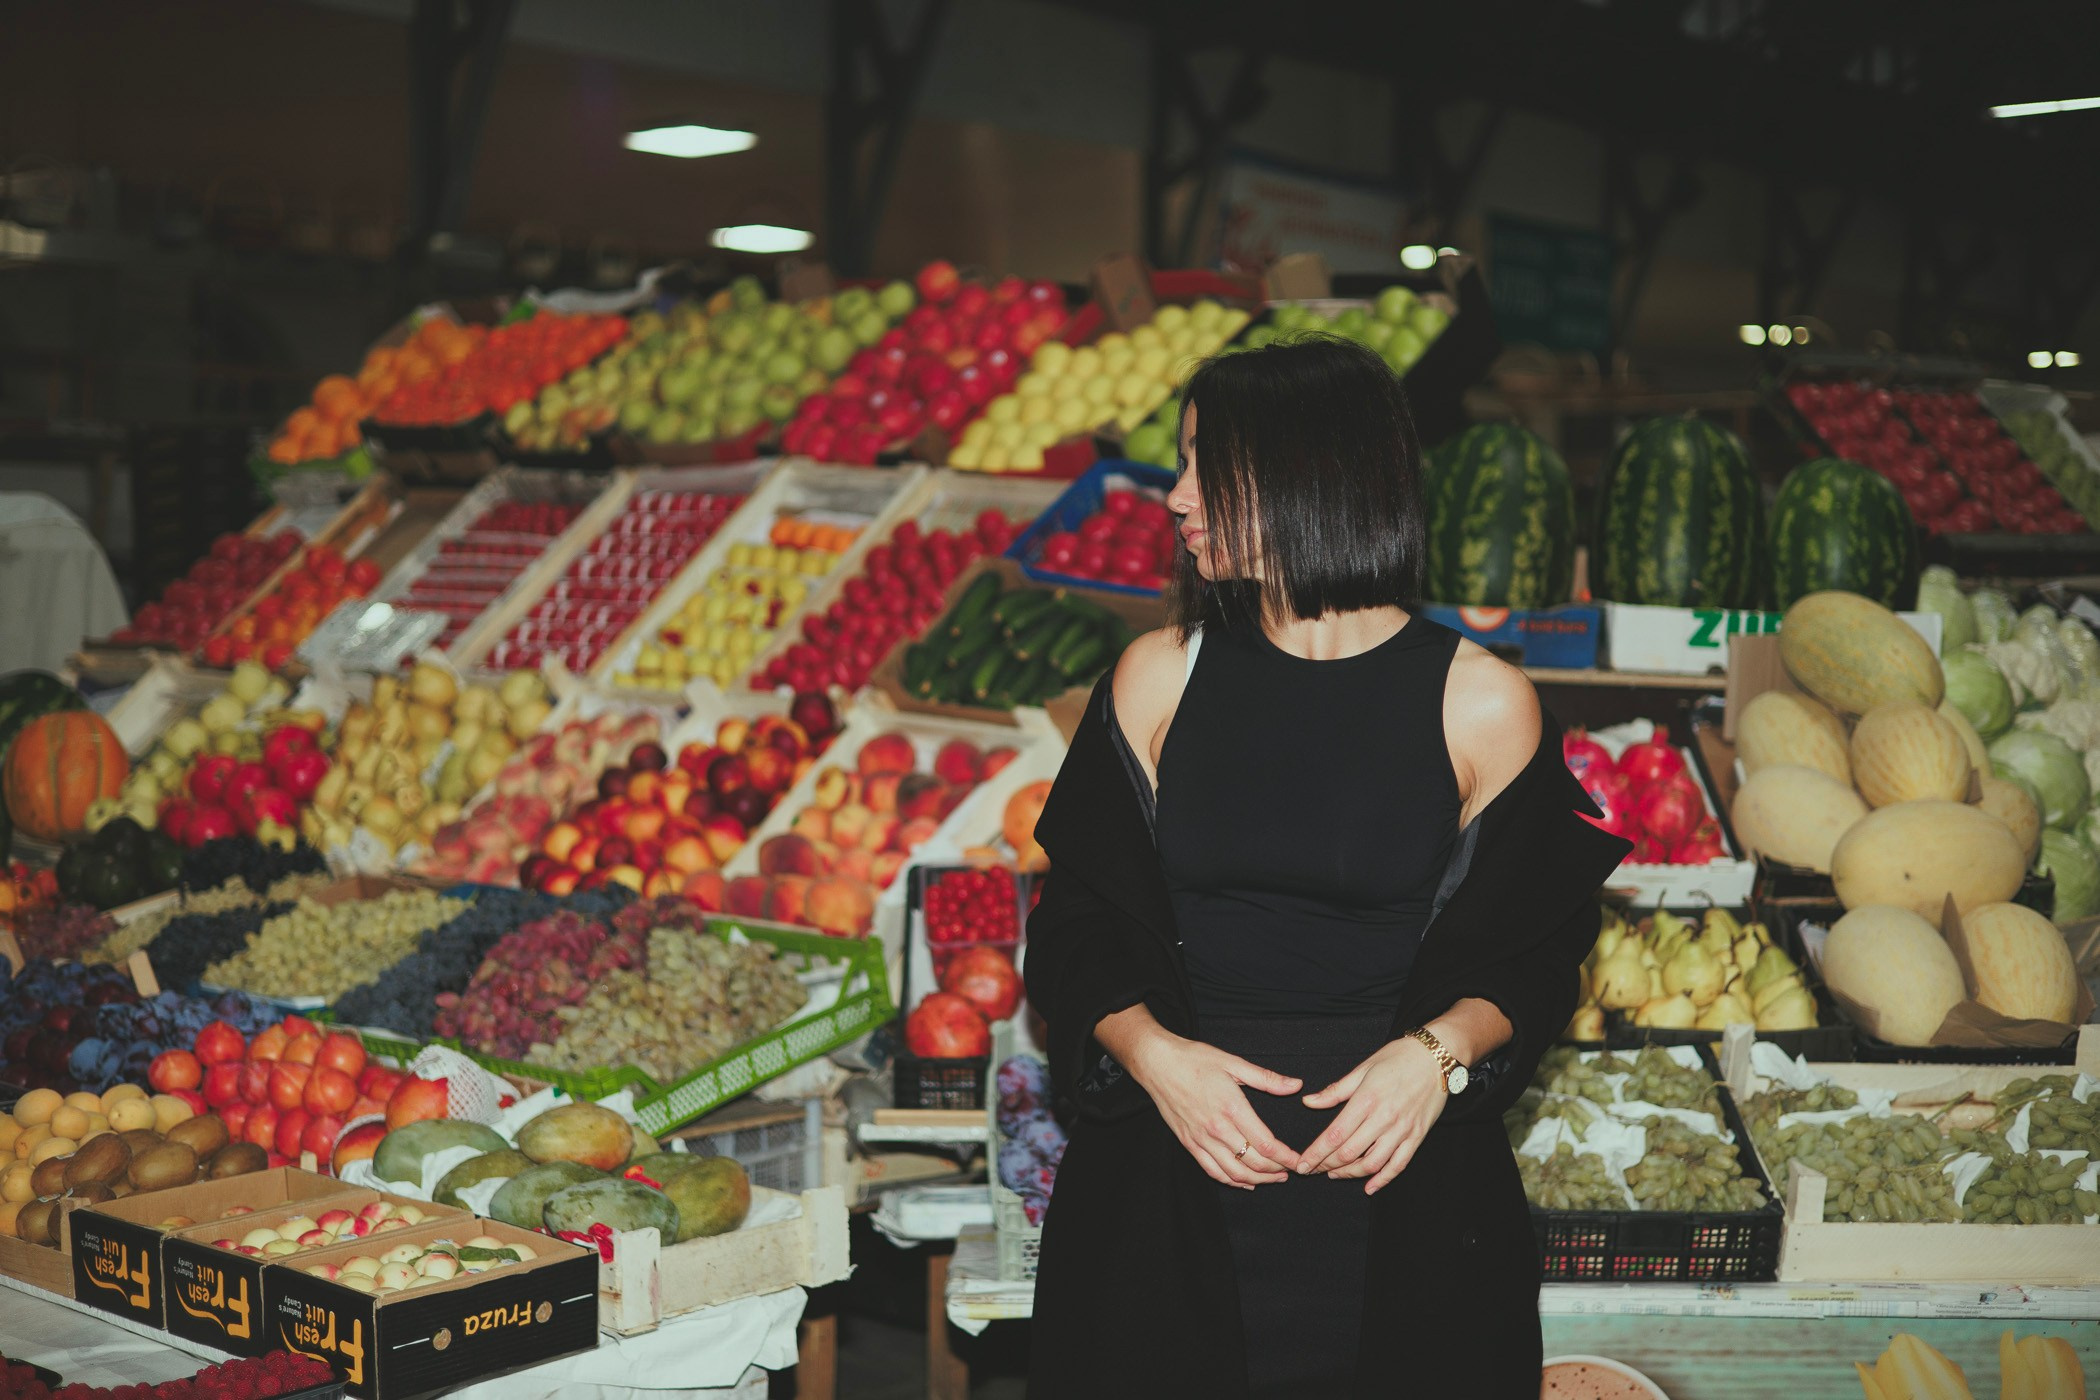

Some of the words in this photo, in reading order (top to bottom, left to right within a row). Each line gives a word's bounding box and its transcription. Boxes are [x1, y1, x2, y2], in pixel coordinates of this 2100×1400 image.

[84, 1231, 100, 1243] Candy
[177, 1257, 194, 1270] Candy
[173, 1266, 194, 1279] Nature's
[283, 1295, 302, 1309] Candy
[278, 1304, 302, 1318] Nature's
[463, 1300, 532, 1336] Fruza
